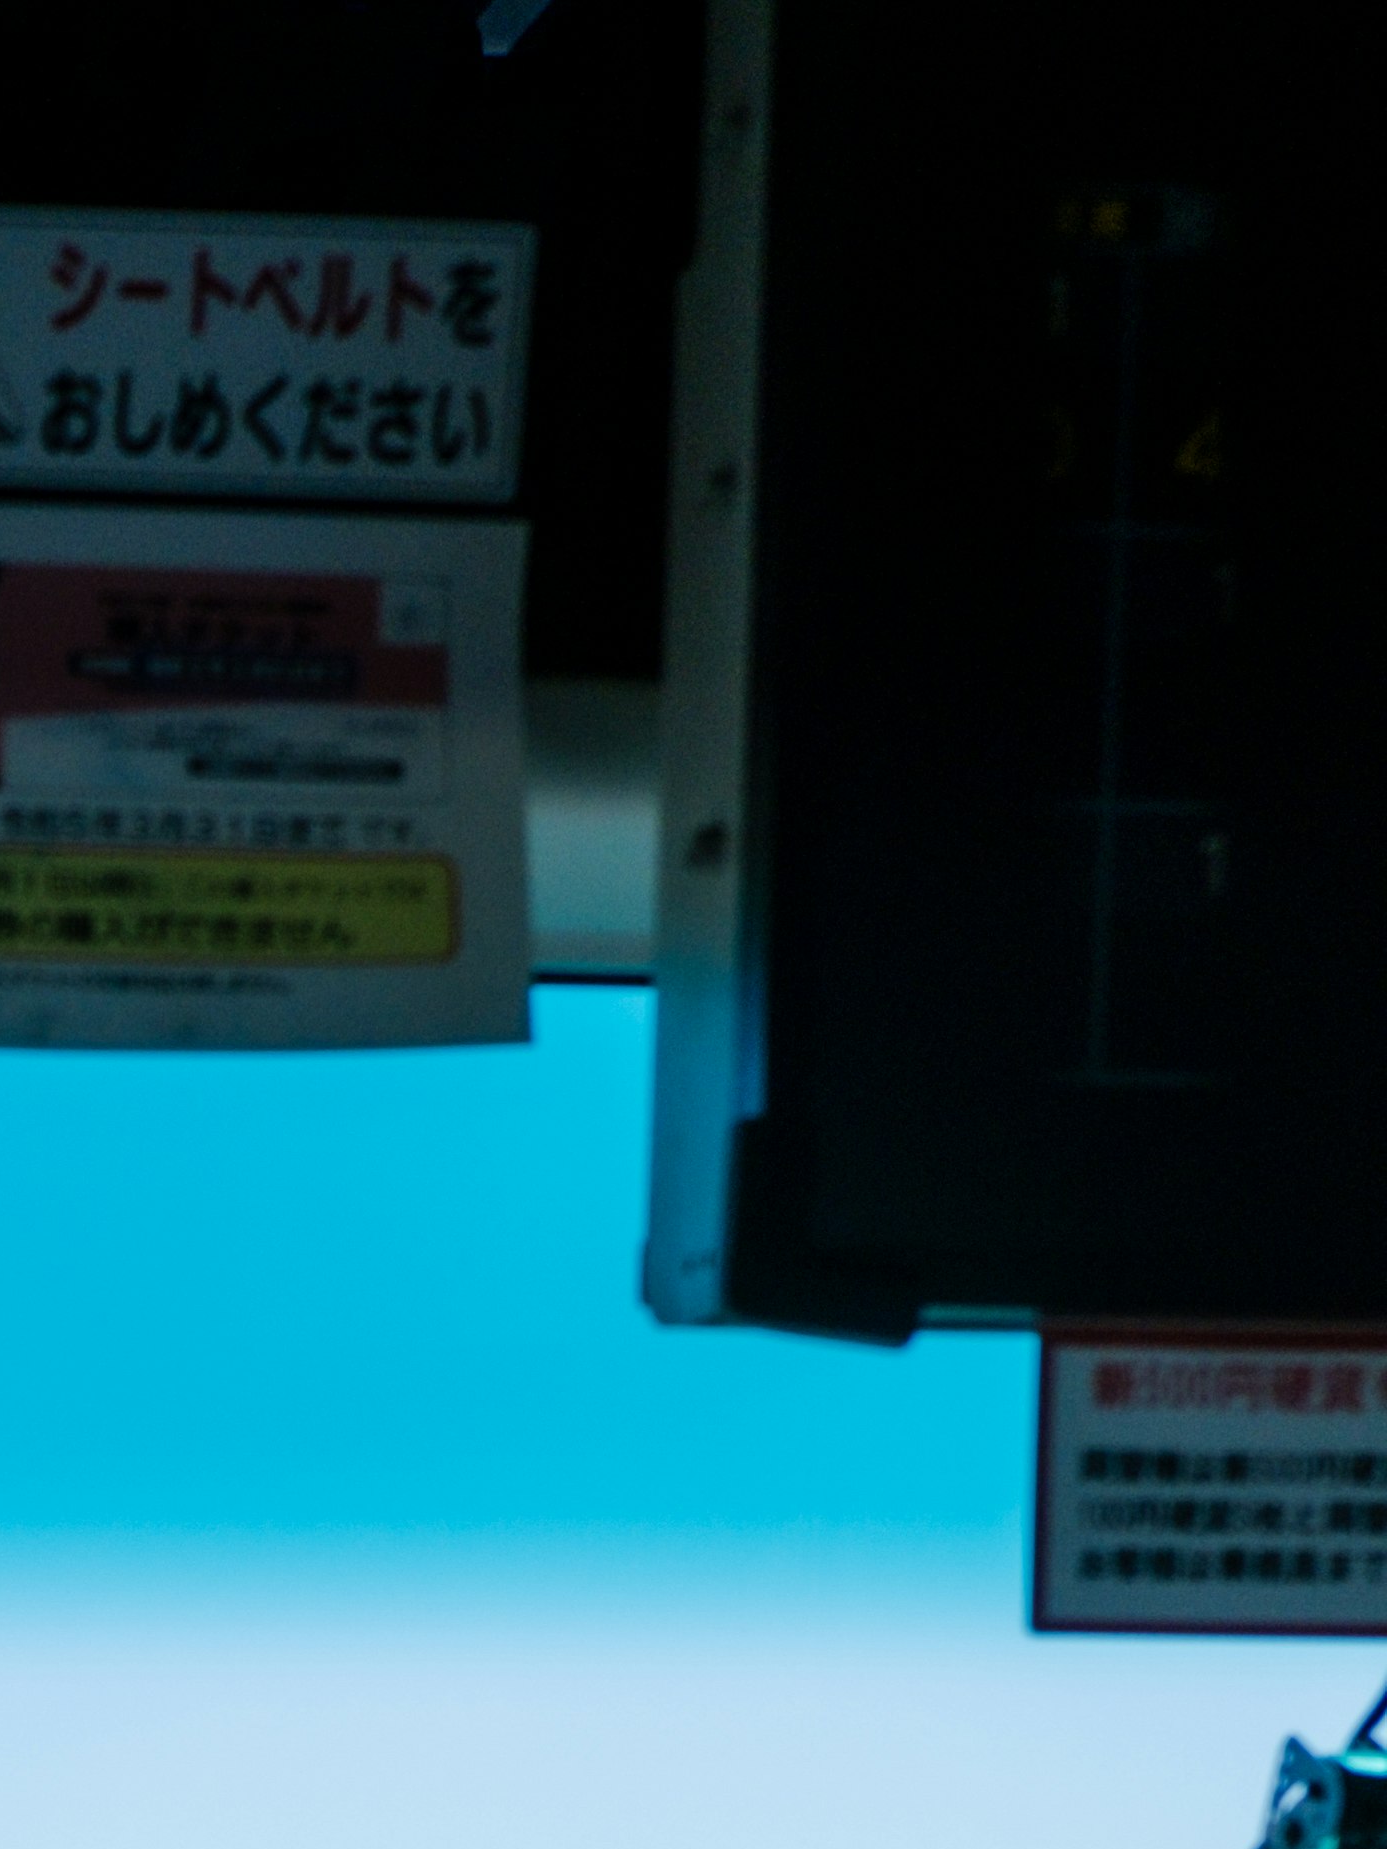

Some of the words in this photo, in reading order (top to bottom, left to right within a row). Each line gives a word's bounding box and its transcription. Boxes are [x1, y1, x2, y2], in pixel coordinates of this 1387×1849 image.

[48, 243, 501, 348] シートベルトを
[40, 368, 491, 465] おしめください
